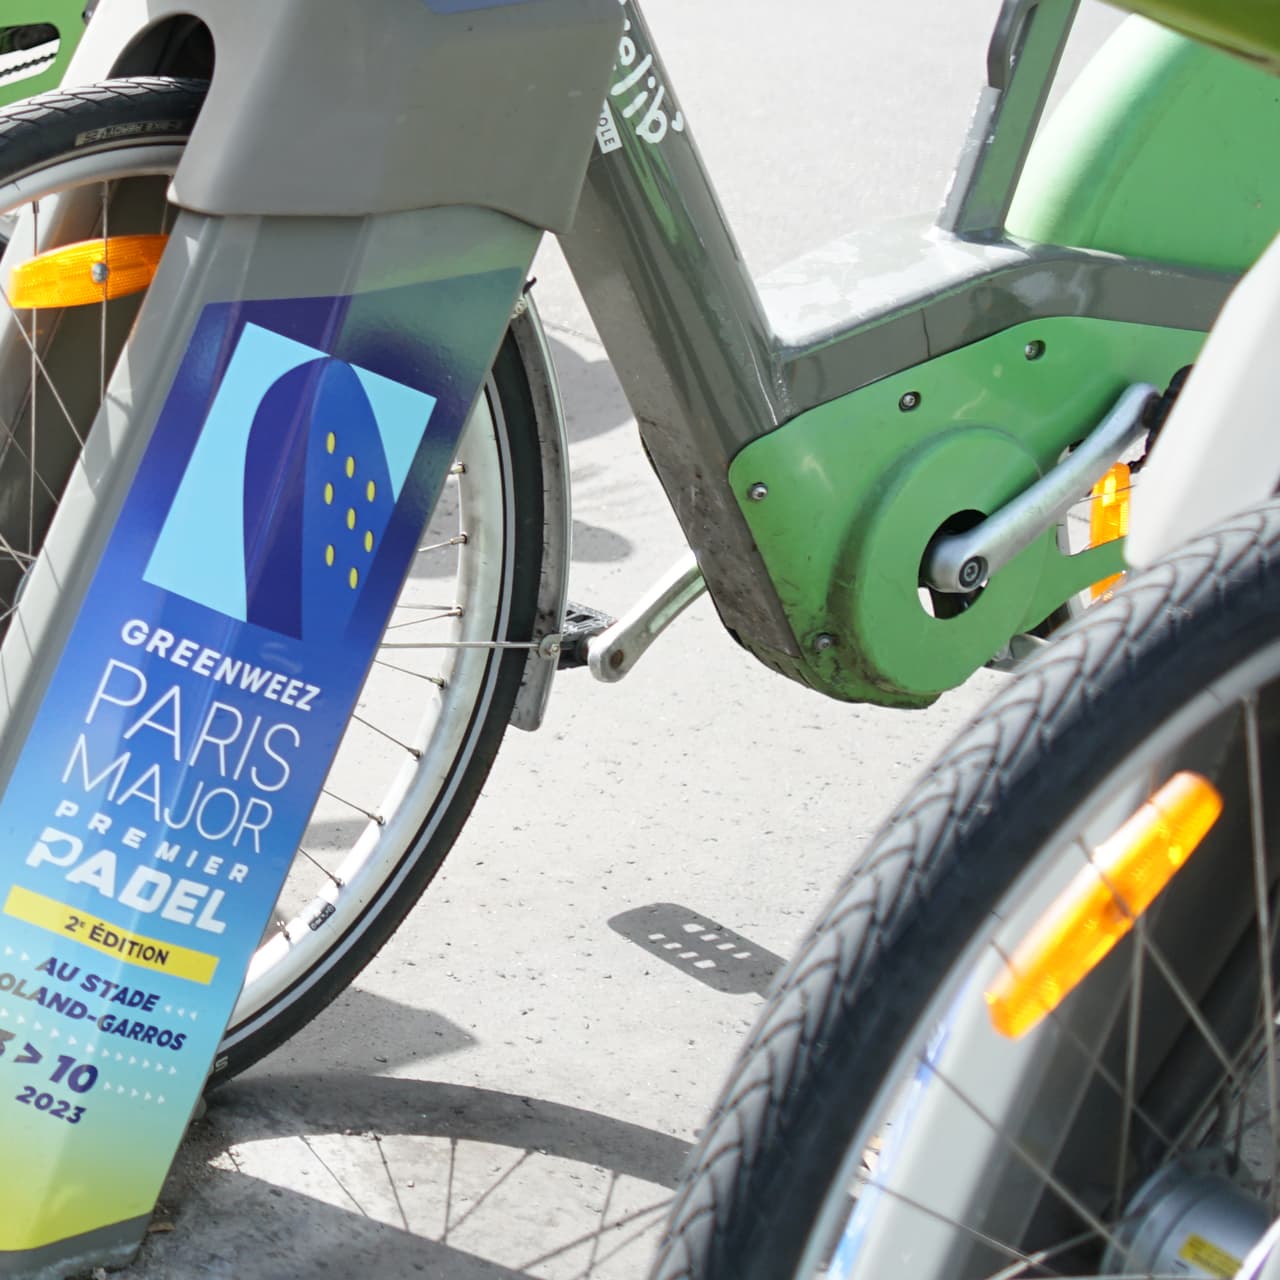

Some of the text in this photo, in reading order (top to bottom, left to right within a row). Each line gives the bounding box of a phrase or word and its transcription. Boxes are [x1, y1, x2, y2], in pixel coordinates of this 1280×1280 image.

[121, 619, 321, 711] GREENWEEZ
[85, 659, 301, 792] PARIS
[61, 733, 272, 853] MAJOR
[25, 827, 227, 934] PADEL
[54, 799, 249, 883] PREMIER
[35, 956, 160, 1012] AU STADE
[89, 922, 170, 966] ÉDITION
[15, 1085, 87, 1124] 2023
